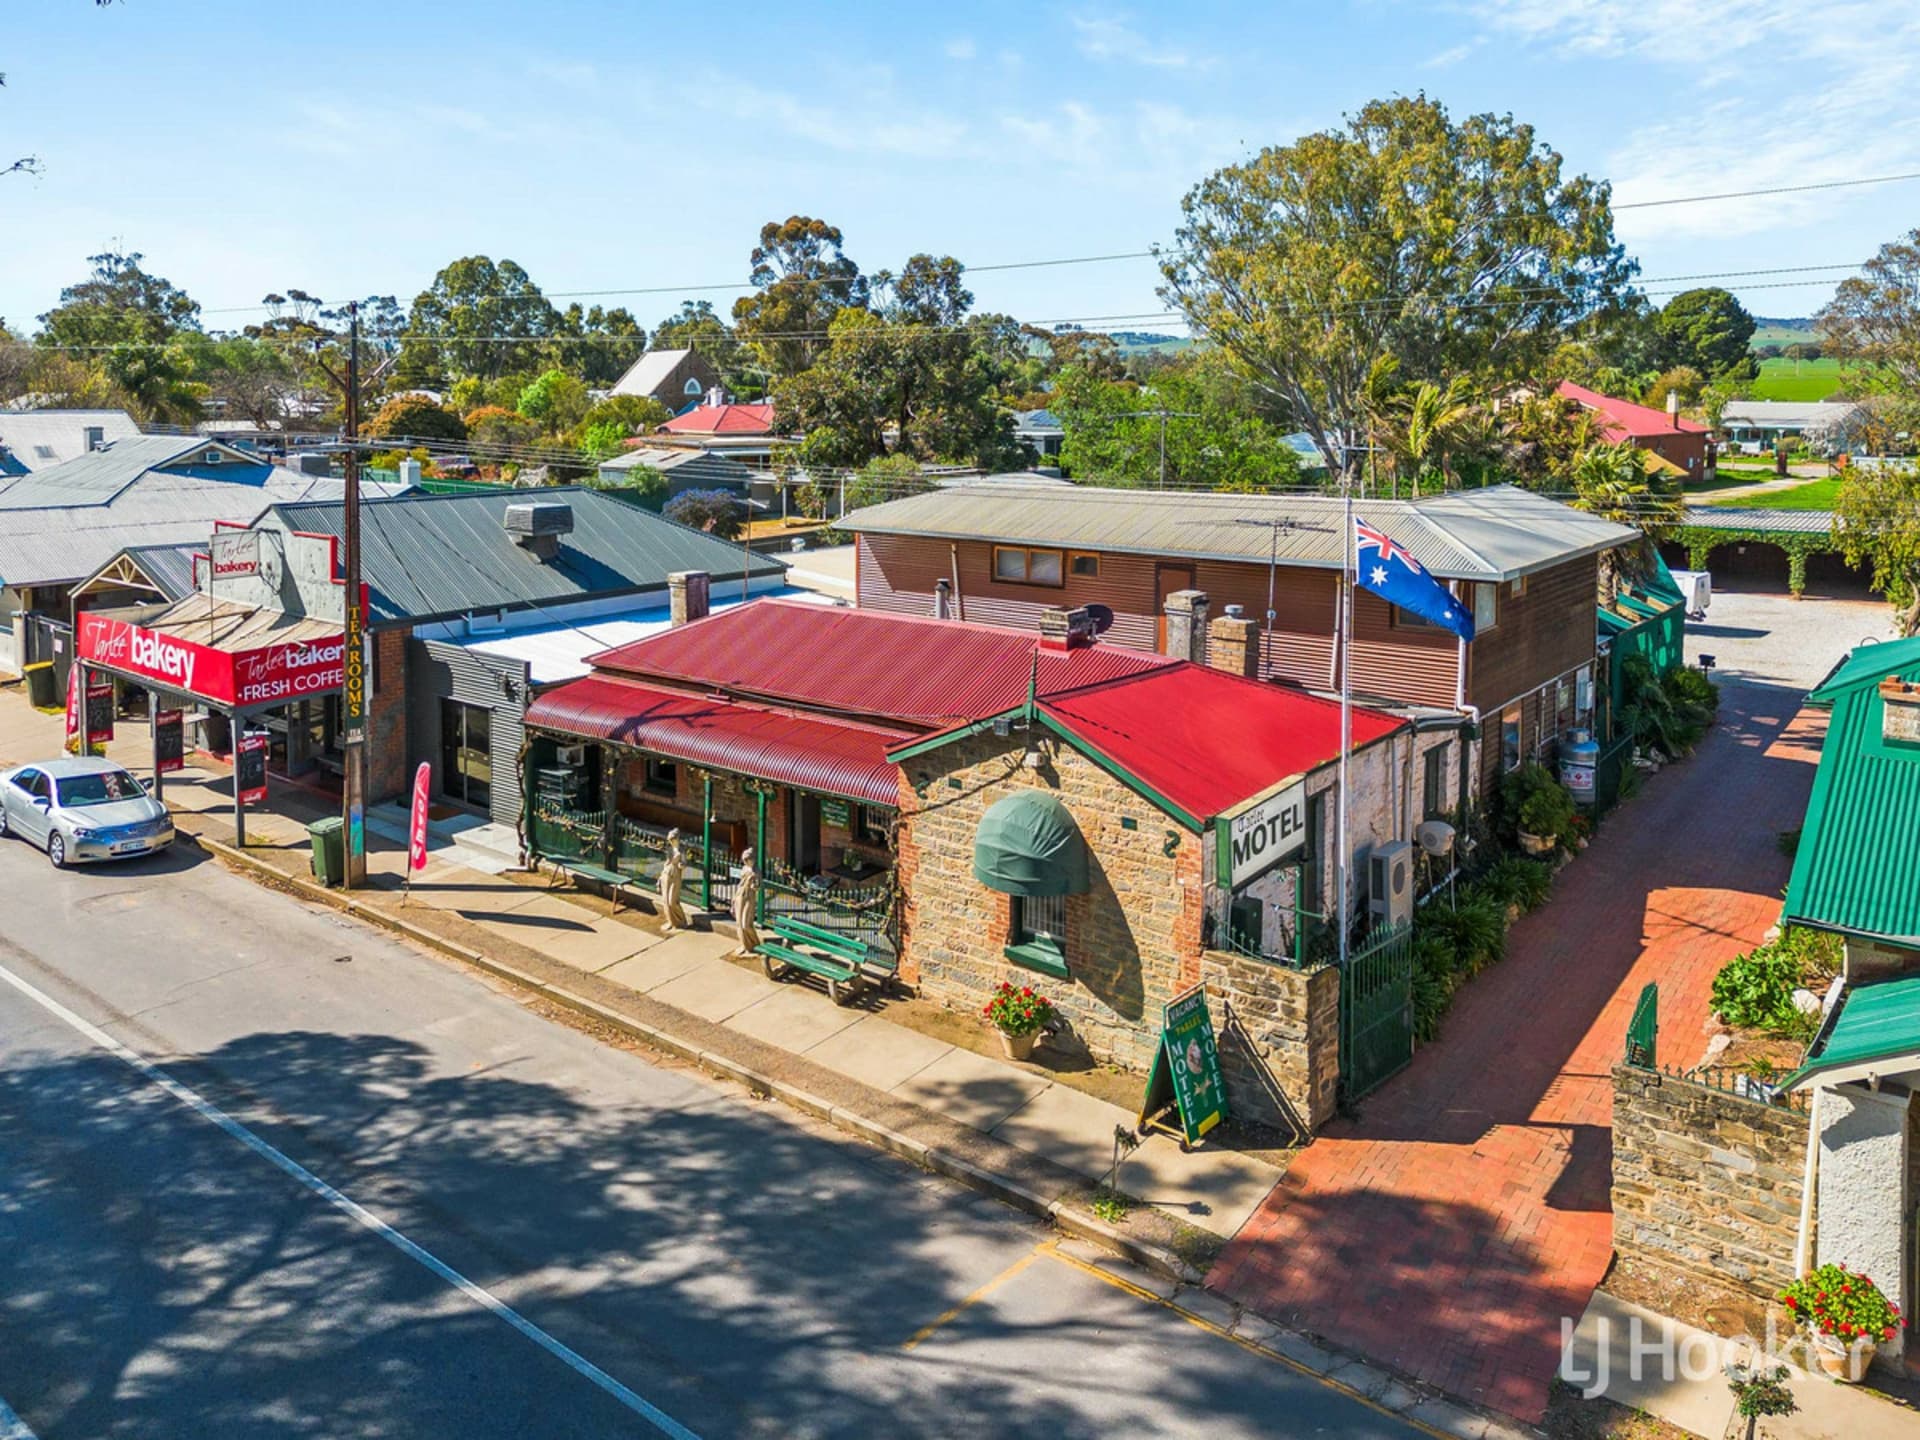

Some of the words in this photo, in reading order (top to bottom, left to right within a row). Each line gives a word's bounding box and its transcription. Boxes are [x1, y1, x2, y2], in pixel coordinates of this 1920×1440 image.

[214, 560, 257, 574] bakery
[86, 620, 130, 664] Tarlee
[131, 625, 195, 689] bakery
[349, 607, 361, 646] TEA
[235, 644, 289, 681] Tarlee
[285, 644, 345, 669] baker
[243, 678, 291, 700] FRESH
[294, 668, 344, 691] COFFE
[347, 650, 362, 717] ROOMS
[1232, 804, 1304, 870] MOTEL
[1171, 1040, 1197, 1127] MOTEL
[1201, 1022, 1225, 1104] MOTEL
